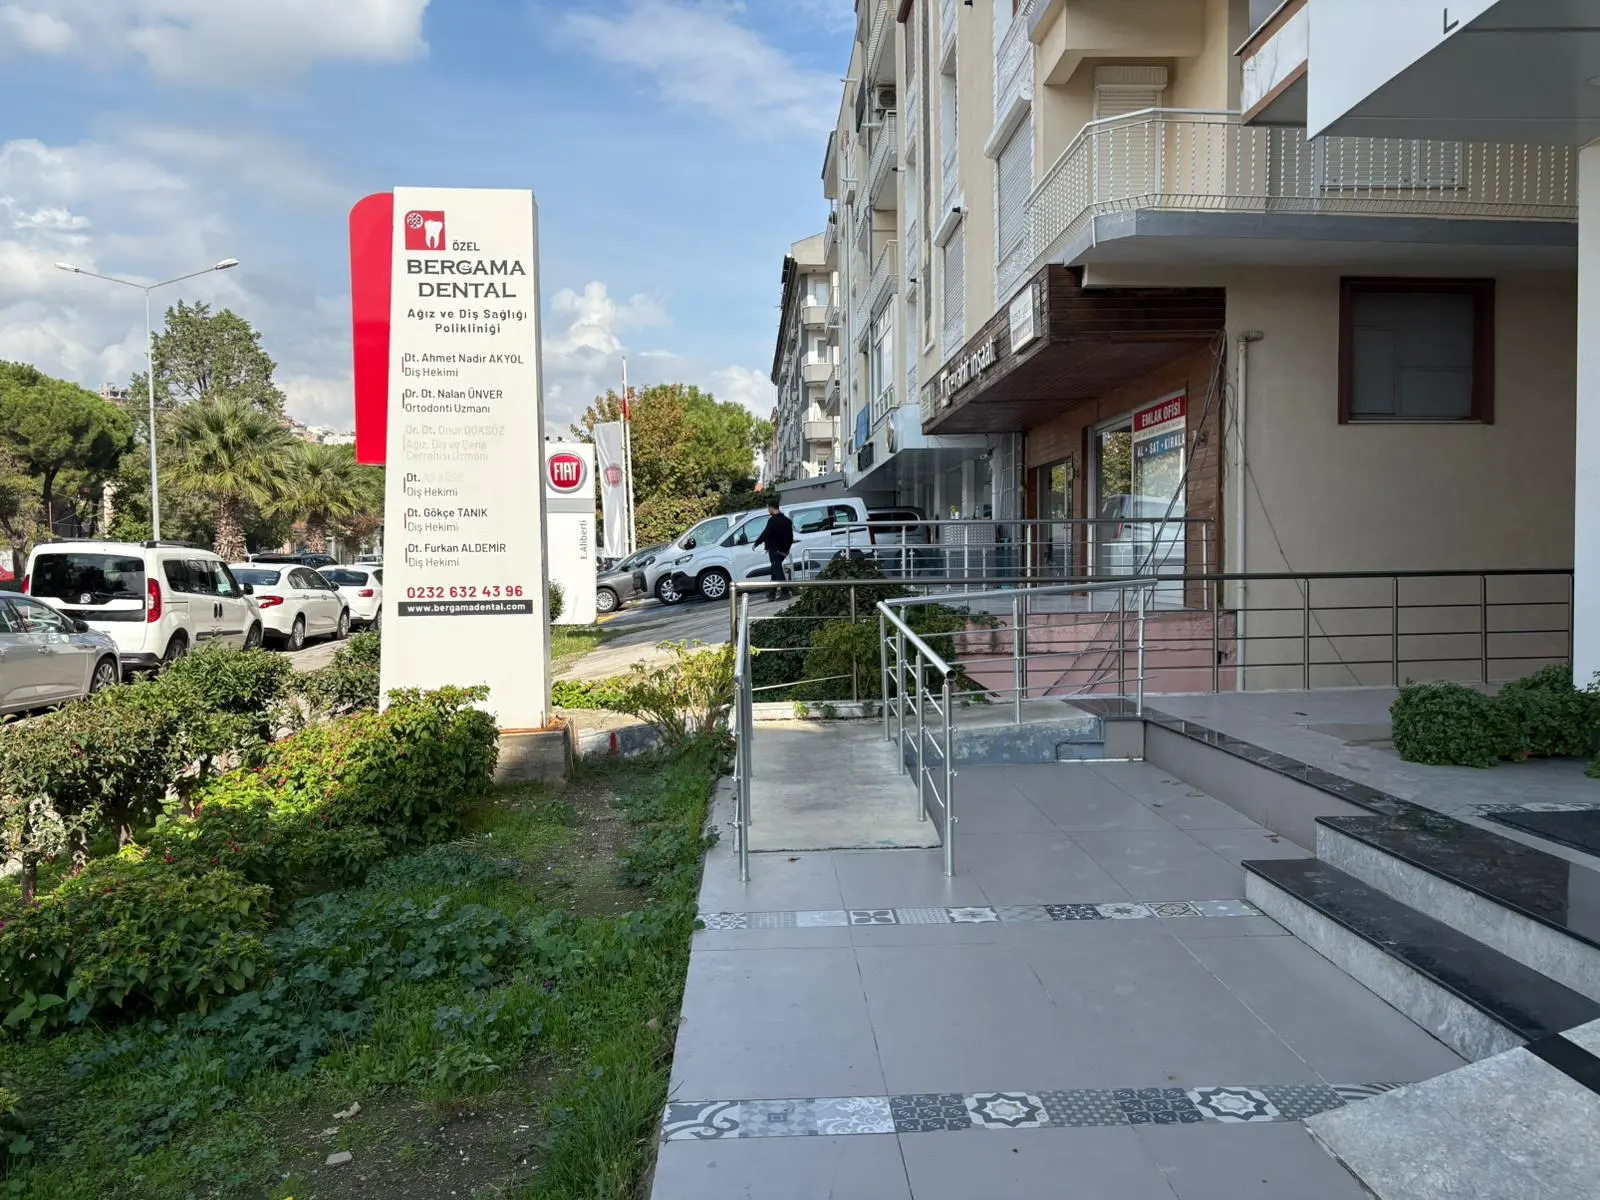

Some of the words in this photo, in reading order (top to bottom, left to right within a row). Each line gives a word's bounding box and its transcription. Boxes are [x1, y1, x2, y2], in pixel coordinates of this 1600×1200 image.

[452, 240, 480, 251] ÖZEL
[406, 259, 526, 275] BERGAMA
[418, 282, 517, 298] DENTAL
[407, 309, 435, 321] Ağız
[459, 309, 478, 320] Diş
[483, 309, 527, 321] Sağlığı
[435, 323, 501, 335] Polikliniği
[404, 353, 419, 362] Dt.
[421, 353, 456, 363] Ahmet
[458, 354, 487, 363] Nadir
[489, 354, 524, 364] AKYOL
[404, 367, 421, 378] Diş
[423, 367, 459, 377] Hekimi
[405, 389, 419, 398] Dr.
[421, 389, 435, 398] Dt.
[438, 389, 466, 399] Nalan
[468, 387, 503, 399] ÜNVER
[405, 403, 452, 413] Ortodonti
[454, 404, 490, 413] Uzmanı
[1142, 407, 1163, 427] EMLAK
[1163, 398, 1181, 420] OFİSİ
[1149, 440, 1159, 454] SAT
[553, 461, 578, 481] FIAT
[406, 473, 421, 482] Dt.
[406, 487, 422, 498] Diş
[424, 487, 458, 496] Hekimi
[407, 508, 421, 517] Dt.
[423, 508, 455, 519] Gökçe
[457, 508, 488, 517] TANIK
[408, 522, 423, 533] Diş
[425, 522, 459, 532] Hekimi
[580, 519, 588, 560] E.Aliberti
[408, 544, 422, 553] Dt.
[425, 544, 459, 553] Furkan
[461, 541, 506, 553] ALDEMİR
[408, 558, 423, 568] Diş
[426, 558, 460, 567] Hekimi
[407, 587, 445, 598] 0232
[449, 586, 477, 598] 632
[482, 586, 500, 597] 43
[505, 585, 523, 597] 96
[407, 602, 526, 613] www.bergamadental.com
